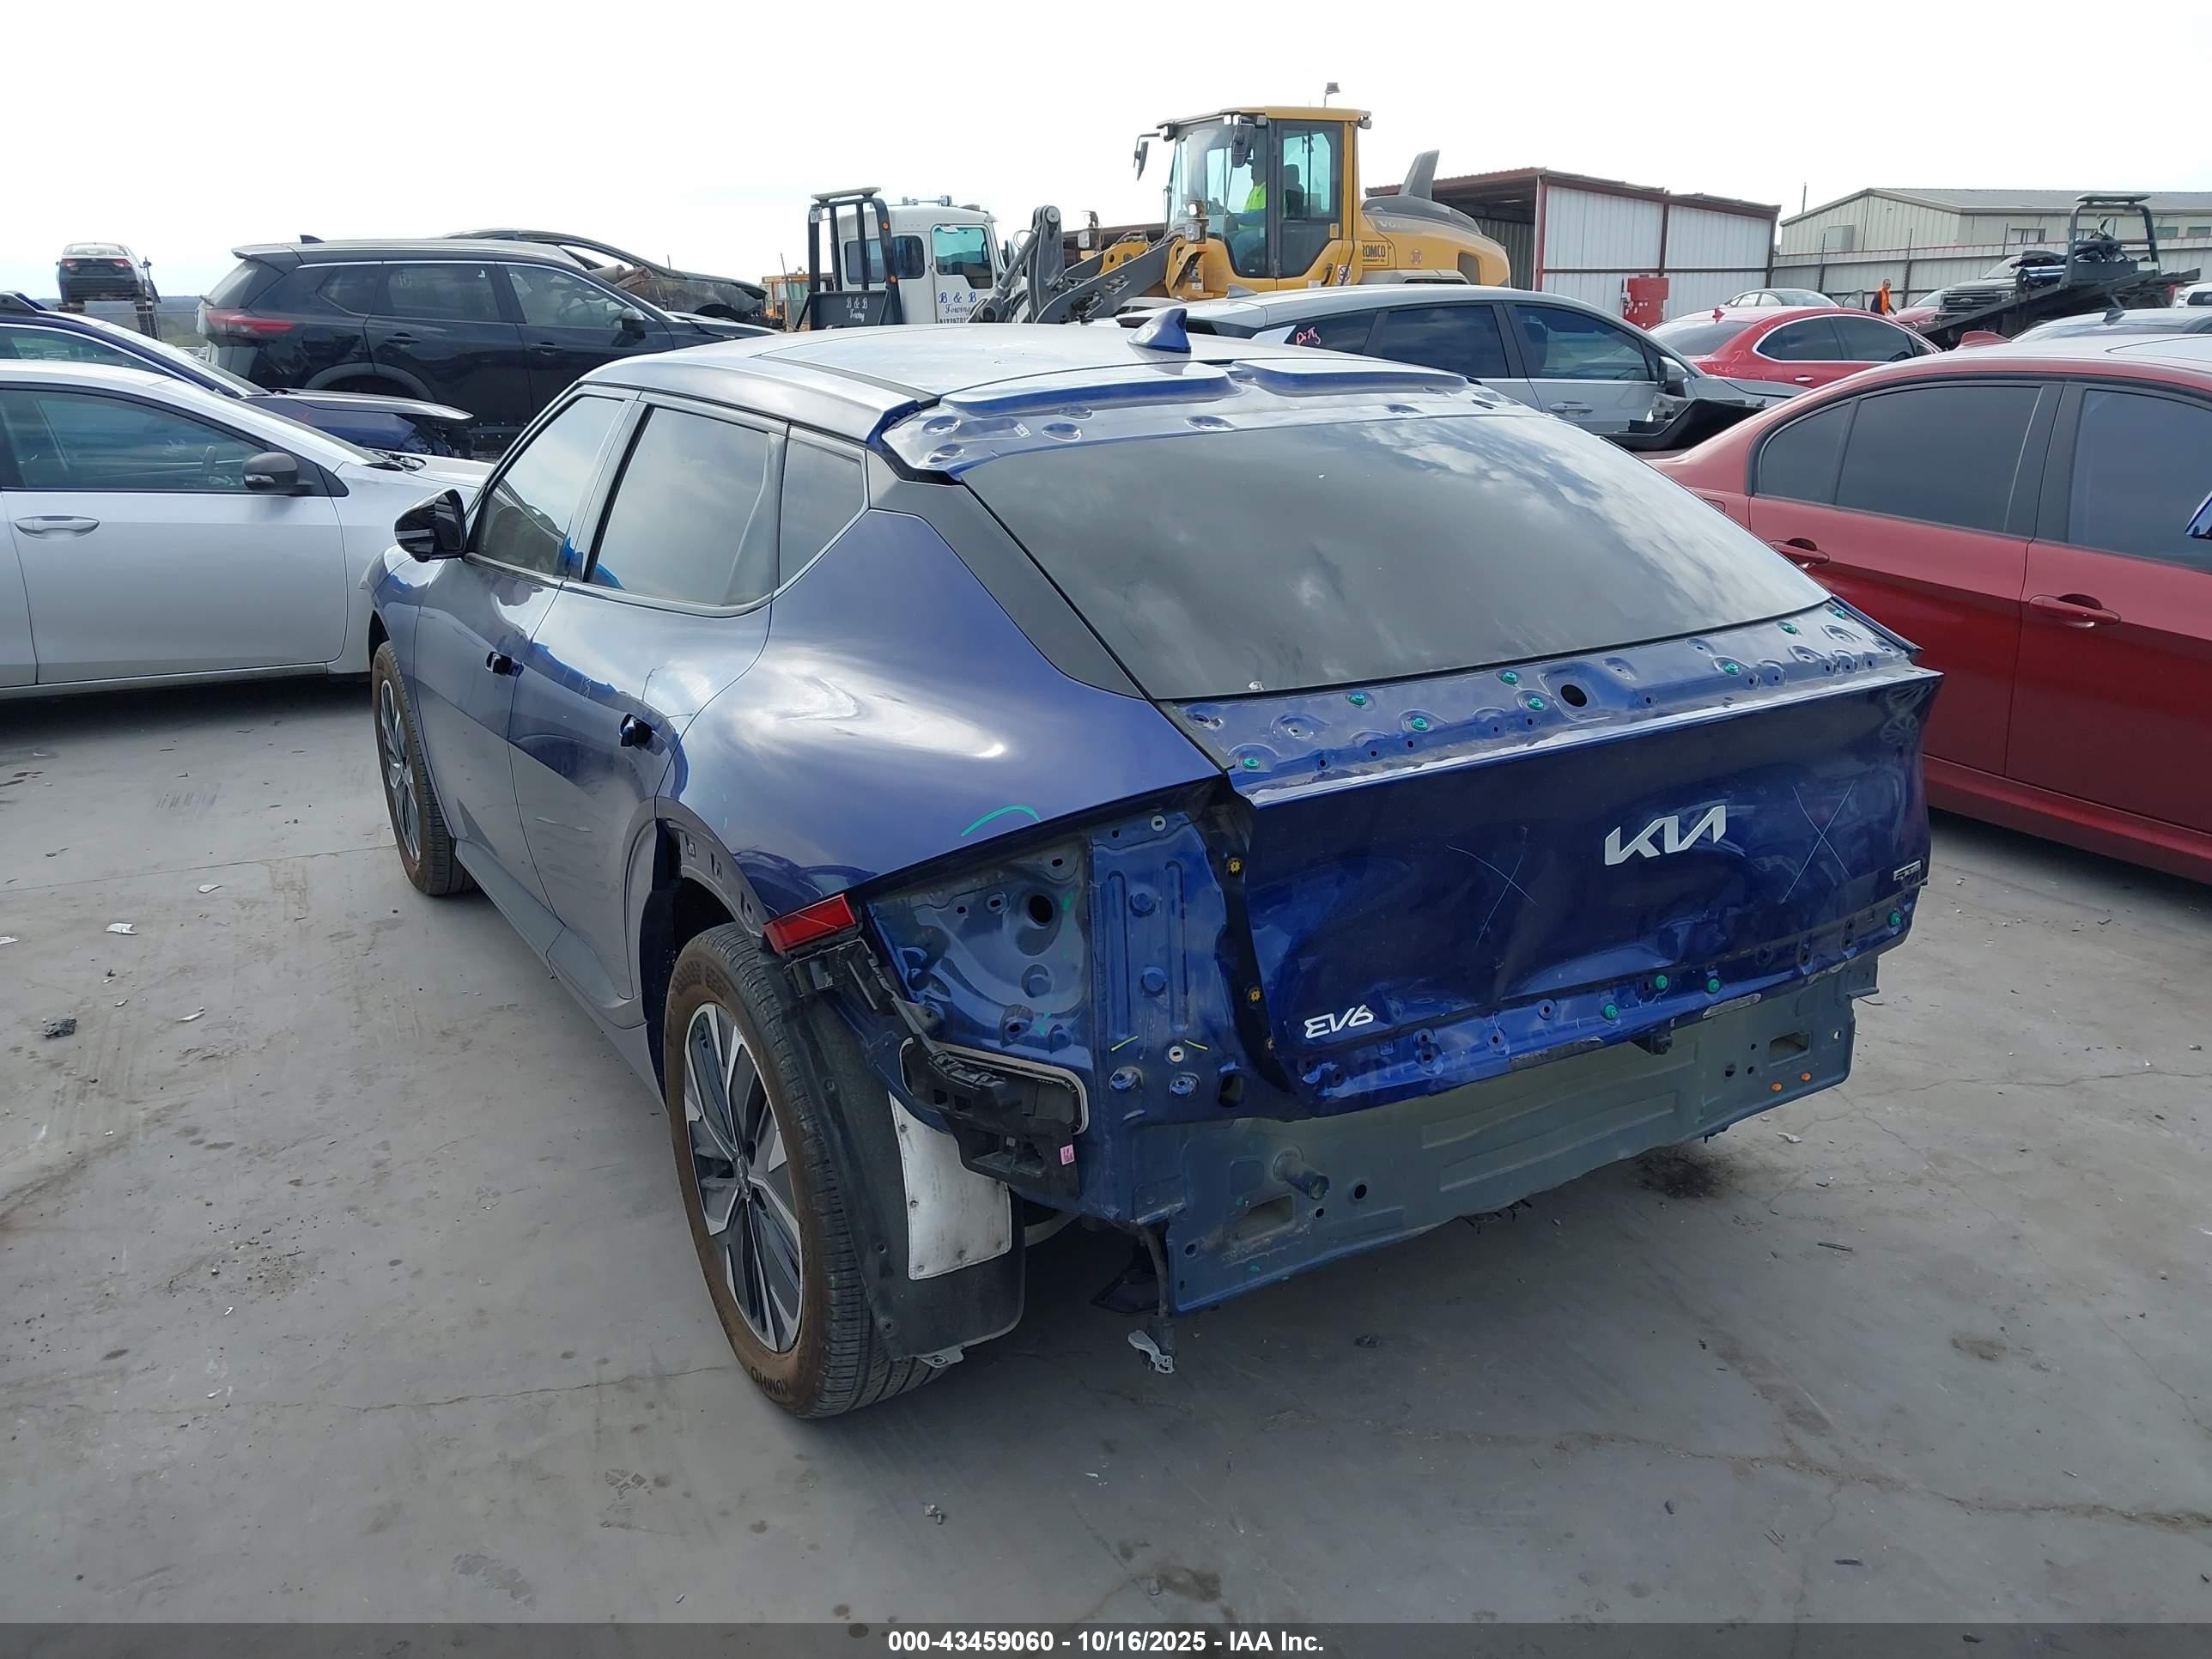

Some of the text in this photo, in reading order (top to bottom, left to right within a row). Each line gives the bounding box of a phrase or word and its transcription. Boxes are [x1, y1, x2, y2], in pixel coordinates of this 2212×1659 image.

[846, 296, 868, 309] B & B
[939, 291, 977, 304] B & B
[945, 304, 971, 316] Towing
[1604, 805, 1727, 866] KIA
[1304, 1004, 1374, 1039] EV6
